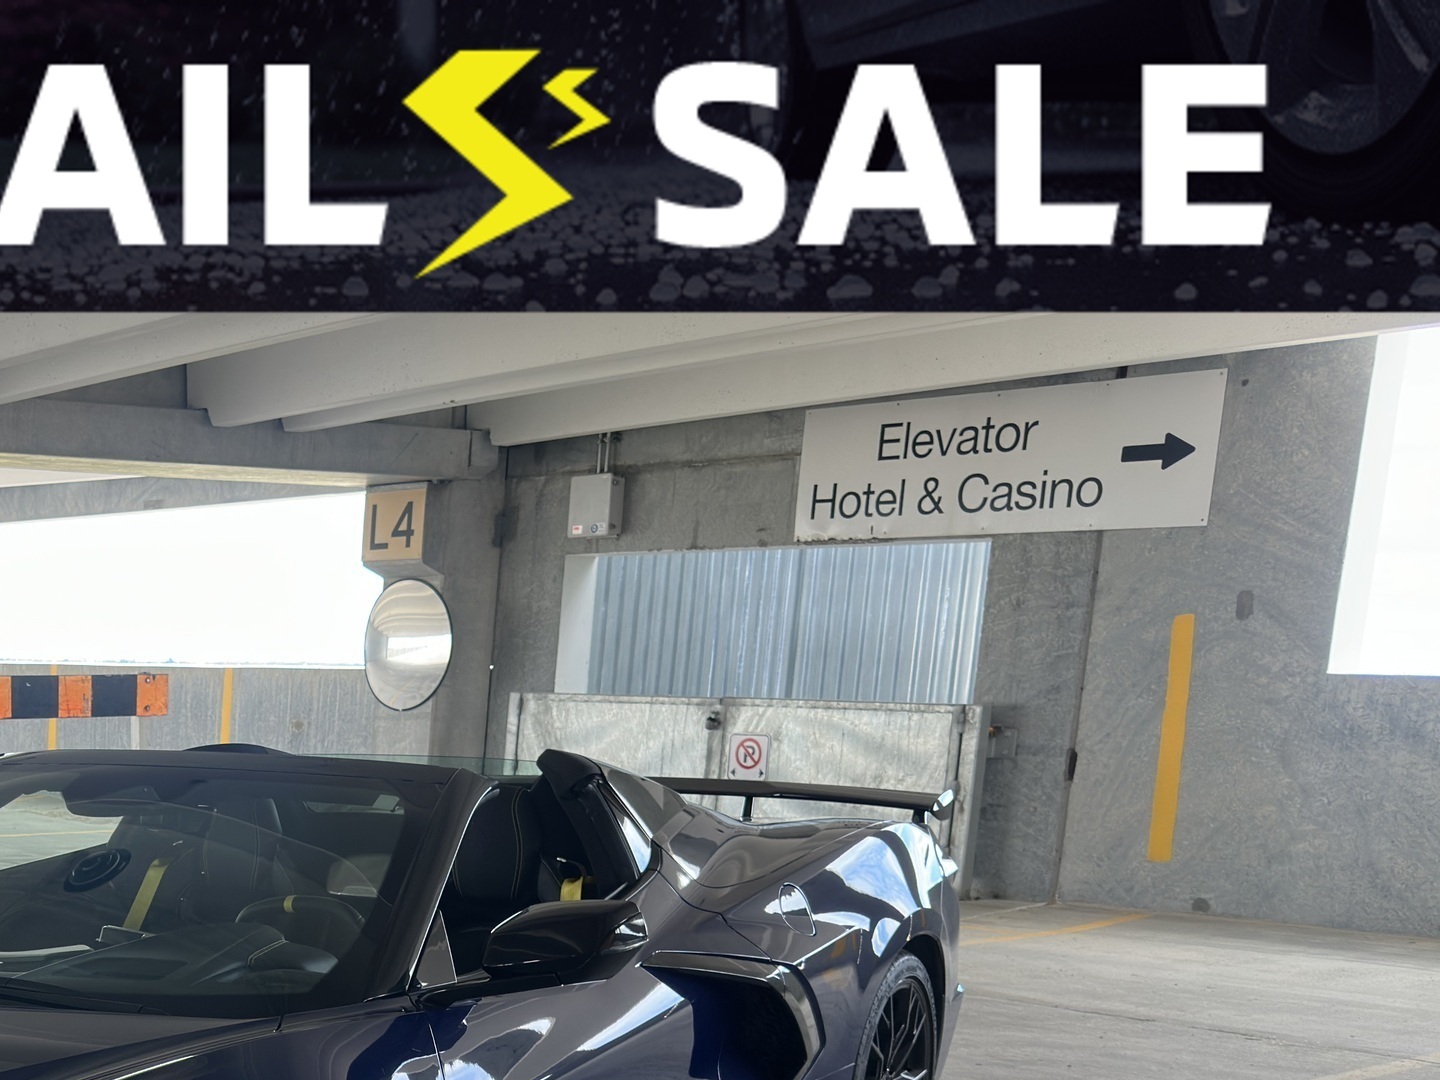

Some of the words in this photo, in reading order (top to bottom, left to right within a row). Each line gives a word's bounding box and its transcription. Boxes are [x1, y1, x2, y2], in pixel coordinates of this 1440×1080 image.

[877, 416, 1040, 462] Elevator
[810, 479, 906, 520] Hotel
[917, 477, 945, 516] &
[957, 469, 1104, 514] Casino
[369, 501, 415, 551] L4
